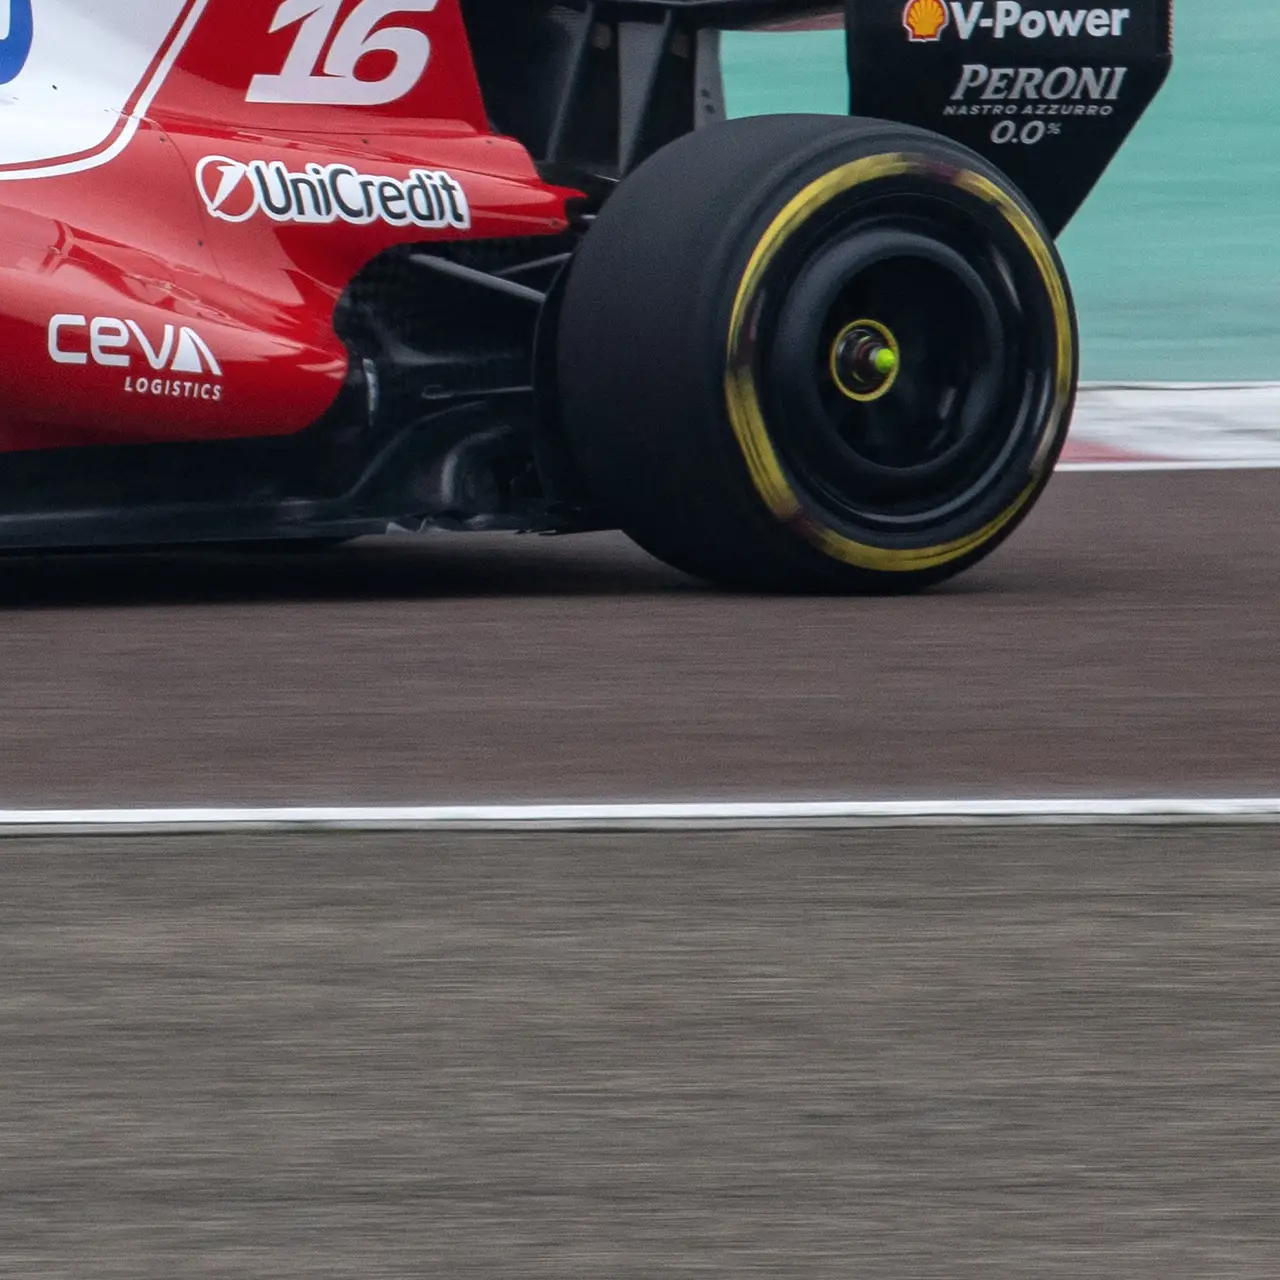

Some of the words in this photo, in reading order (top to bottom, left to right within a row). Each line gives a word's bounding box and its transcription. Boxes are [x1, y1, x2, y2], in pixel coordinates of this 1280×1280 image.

[949, 0, 1131, 41] V-Power
[948, 63, 1128, 101] PERONI
[942, 104, 1017, 116] NASTRO
[1021, 104, 1114, 116] AZZURRO
[990, 119, 1062, 144] 0.0%
[251, 163, 467, 225] UniCredit
[124, 376, 223, 402] LOGISTICS
